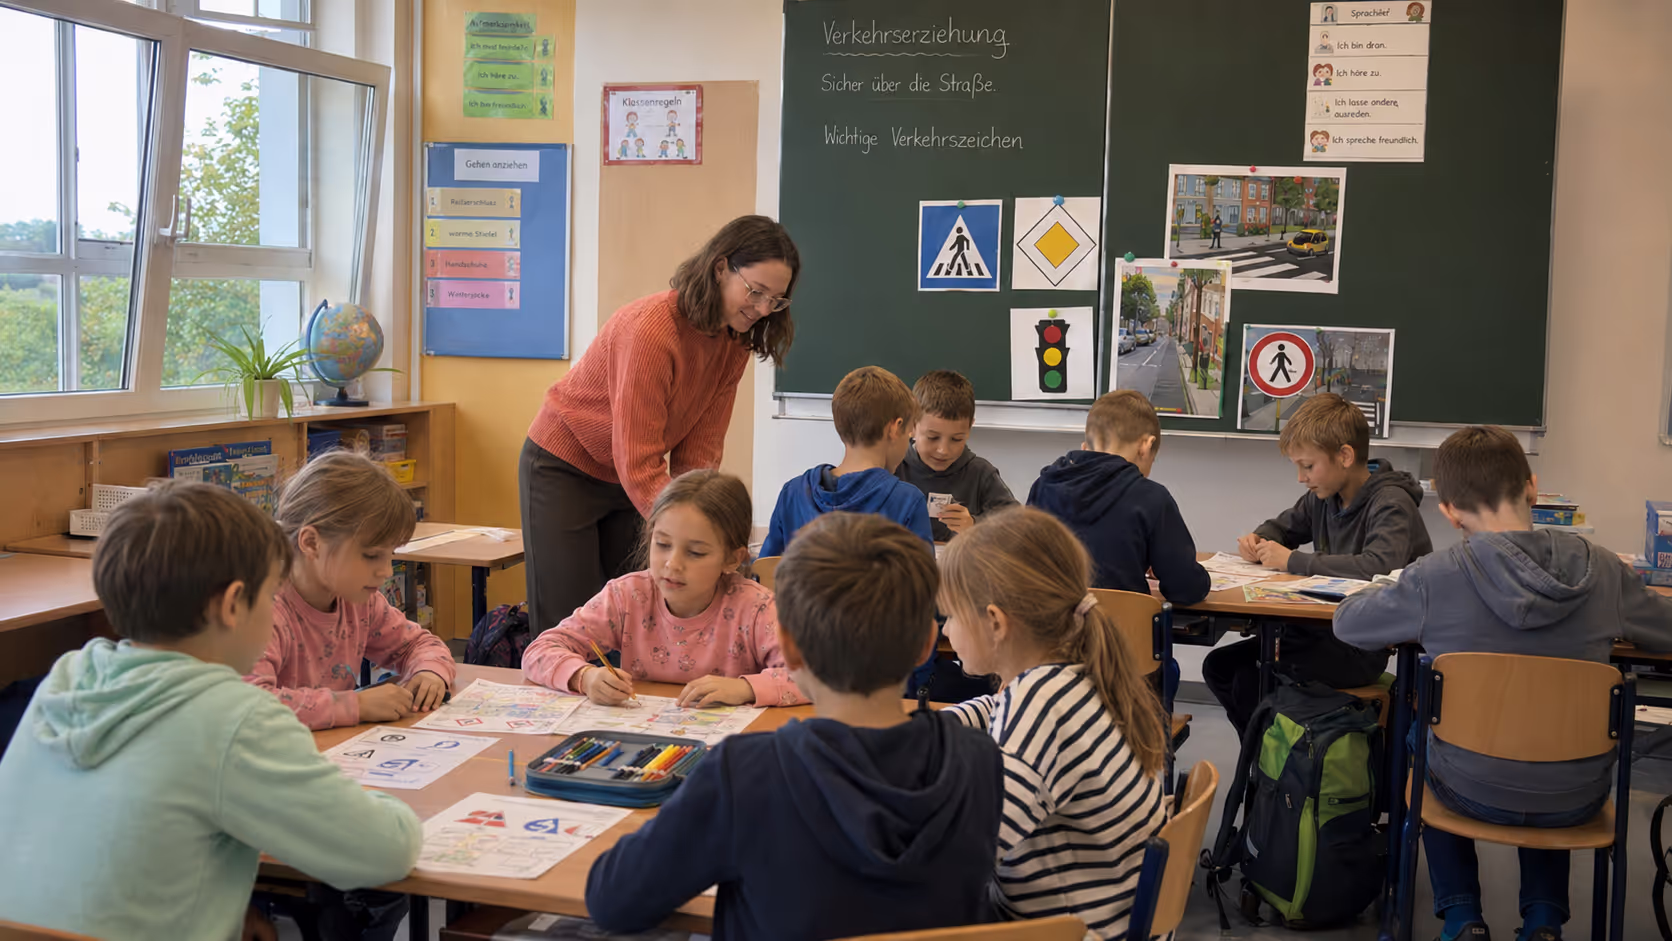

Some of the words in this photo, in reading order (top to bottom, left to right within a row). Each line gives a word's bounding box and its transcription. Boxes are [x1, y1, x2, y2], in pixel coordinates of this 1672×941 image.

[823, 17, 1010, 59] Verkehrserziehung
[1337, 42, 1349, 50] Ich
[1351, 41, 1363, 49] bin
[1336, 69, 1348, 77] Ich
[1350, 69, 1368, 77] höre
[821, 73, 864, 92] Sicher
[872, 75, 901, 92] über
[909, 73, 931, 92] die
[939, 73, 997, 99] Straße.
[622, 96, 682, 108] Klassenregeln
[1334, 98, 1346, 107] Ich
[824, 125, 879, 154] Wichtige
[891, 127, 1024, 149] Verkehrszeichen
[1332, 136, 1344, 144] Ich
[1346, 137, 1377, 145] spreche
[465, 159, 491, 169] Gehen
[492, 161, 528, 170] anziehen
